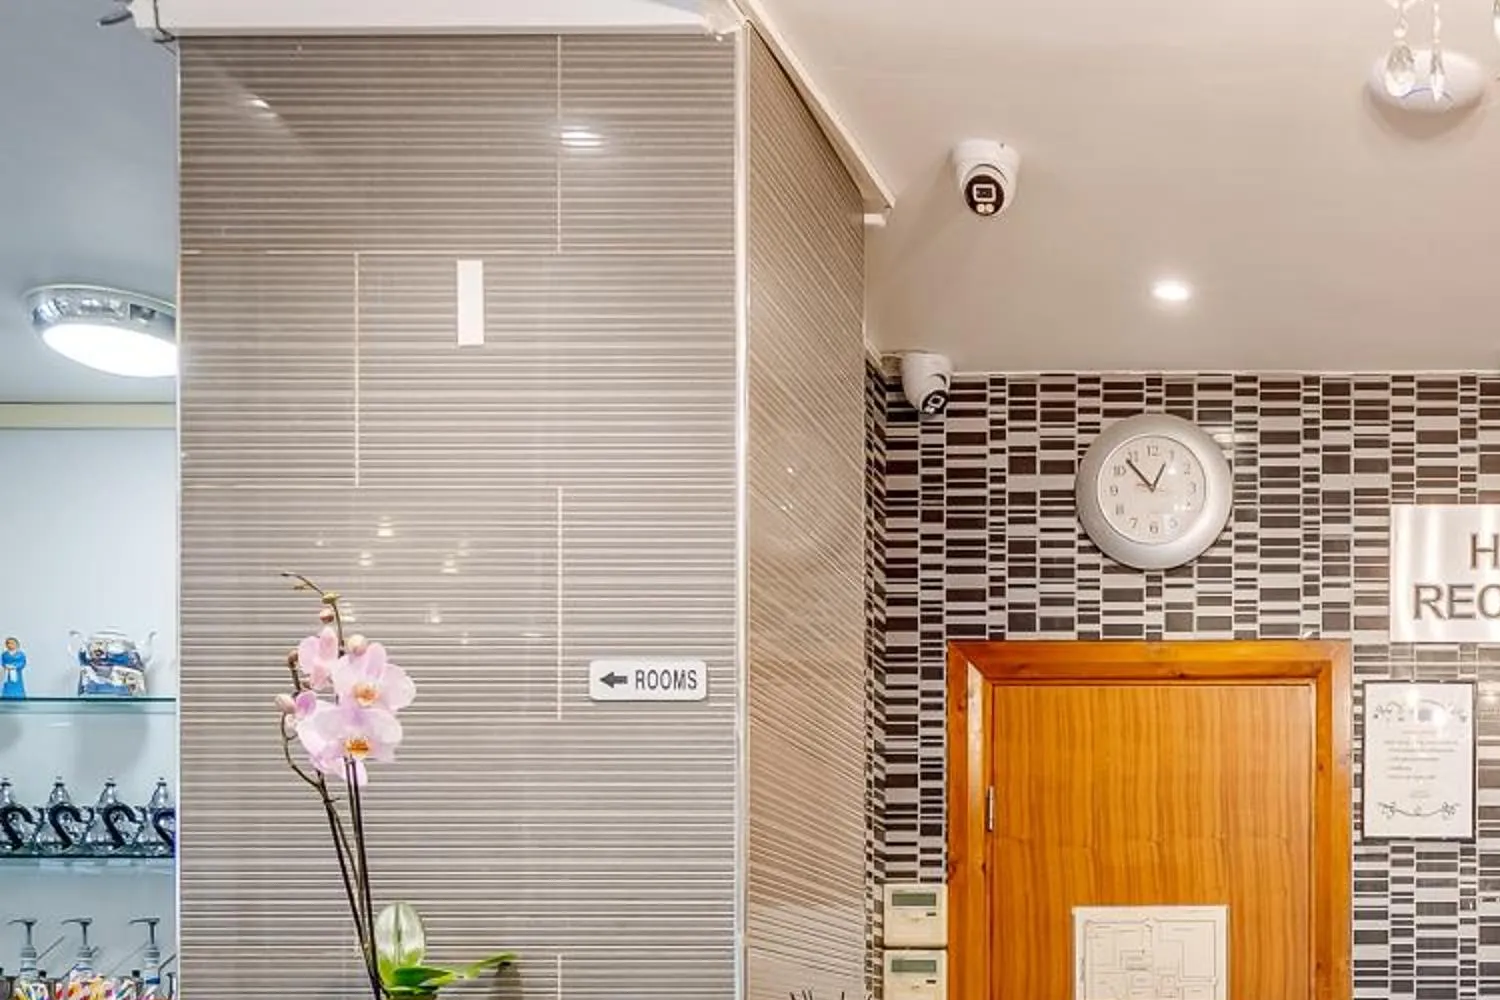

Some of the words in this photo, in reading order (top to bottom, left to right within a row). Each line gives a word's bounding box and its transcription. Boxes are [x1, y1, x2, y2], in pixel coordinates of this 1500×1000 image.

[1128, 451, 1139, 463] 11
[1146, 445, 1159, 457] 12
[1113, 465, 1127, 477] 10
[1110, 484, 1119, 497] 9
[1128, 517, 1138, 529] 7
[1149, 521, 1159, 534] 6
[635, 669, 698, 690] ROOMS
